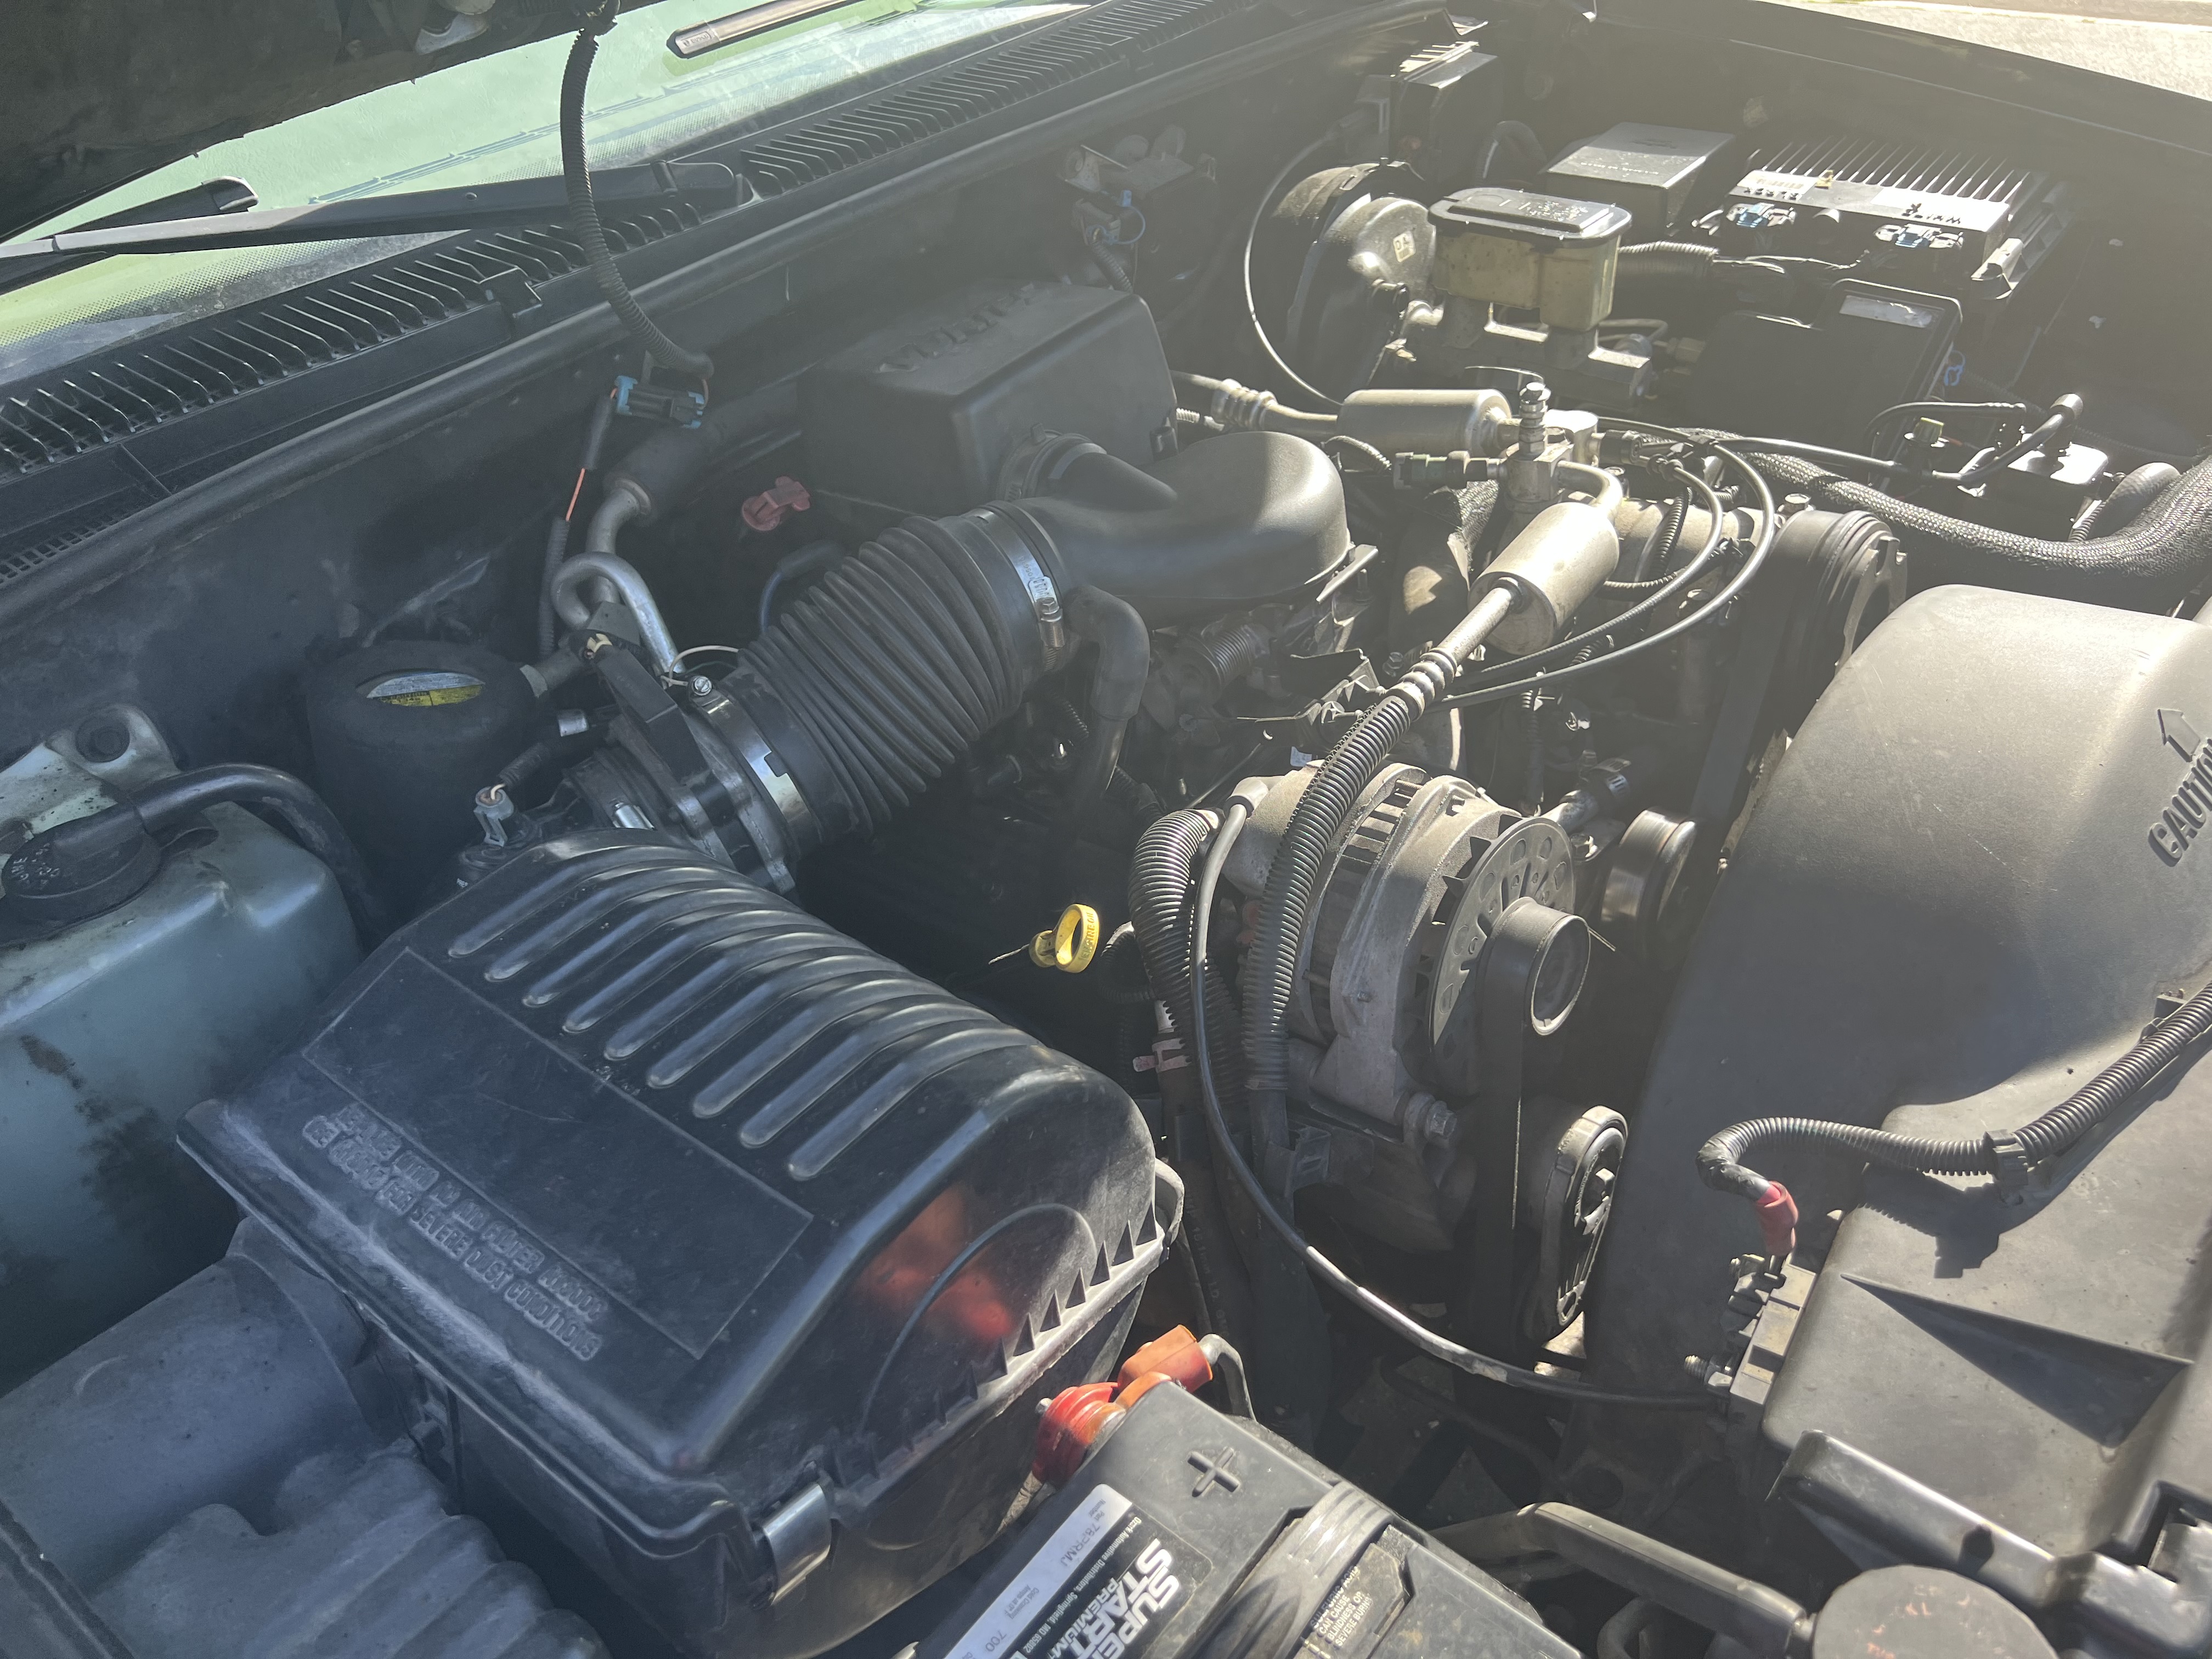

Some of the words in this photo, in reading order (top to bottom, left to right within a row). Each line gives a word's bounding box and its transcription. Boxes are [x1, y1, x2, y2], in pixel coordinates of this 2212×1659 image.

[483, 1219, 544, 1274] FILTER
[378, 1179, 417, 1216] FOR
[408, 1203, 471, 1259] SEVERE
[464, 1246, 512, 1291] DUST
[504, 1279, 601, 1362] CONDITIONS
[1124, 1515, 1141, 1534] Ozark
[1058, 1518, 1101, 1570] 78PRMJ
[1101, 1528, 1130, 1563] Automotive
[1069, 1537, 1173, 1659] START
[1318, 1618, 1333, 1634] CAN
[1330, 1595, 1349, 1618] CAUSE
[1327, 1603, 1356, 1640] BLINDNESS
[1335, 1618, 1357, 1646] SEVERE
[983, 1627, 1007, 1655] 700
[1023, 1632, 1043, 1654] 65802
